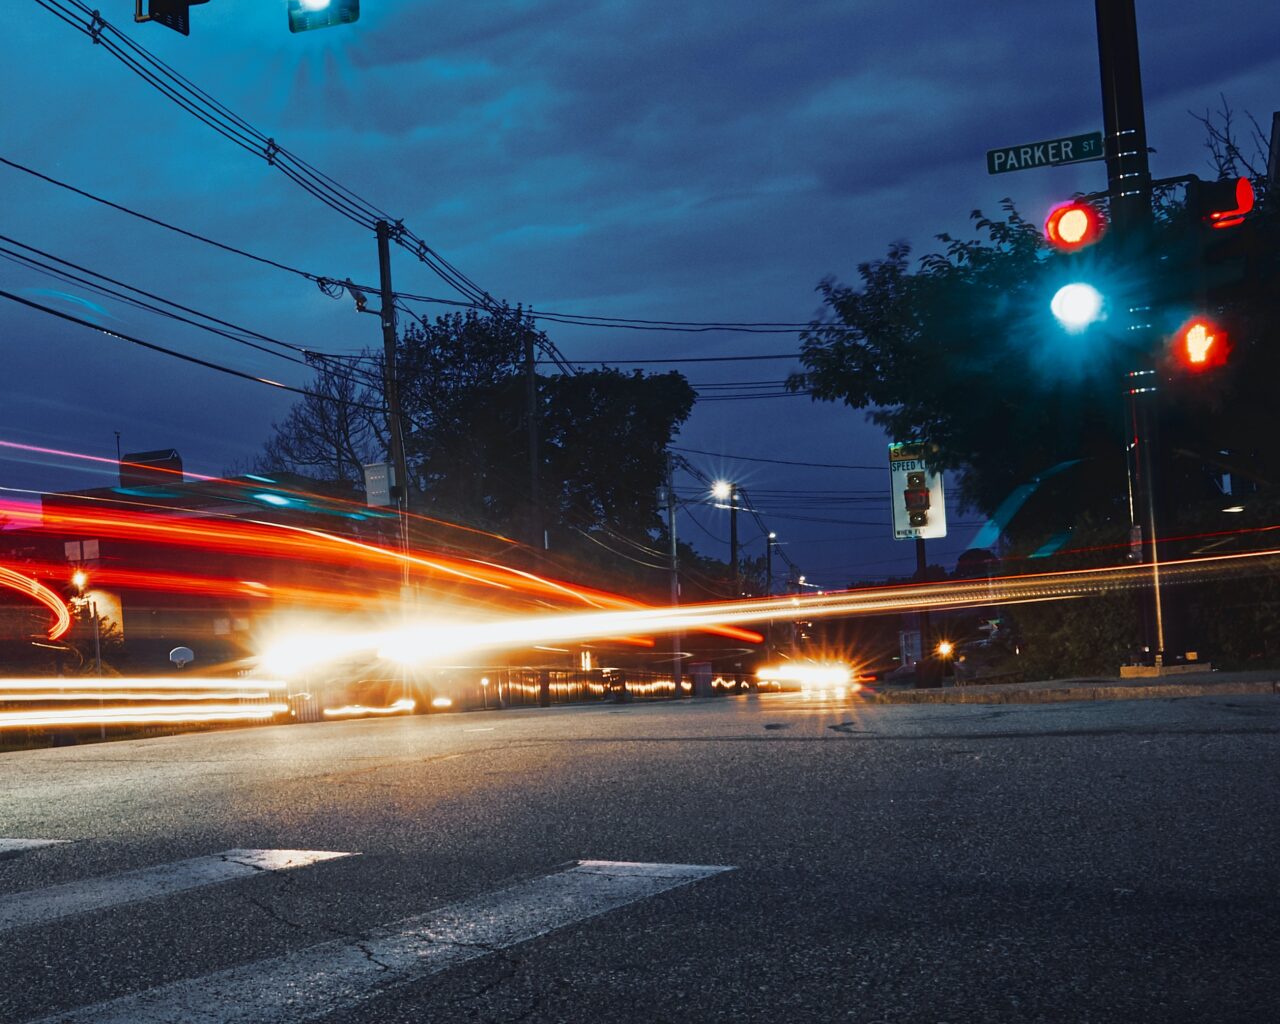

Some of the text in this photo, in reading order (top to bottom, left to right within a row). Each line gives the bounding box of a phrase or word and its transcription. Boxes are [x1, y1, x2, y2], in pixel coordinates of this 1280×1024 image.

[994, 140, 1095, 171] PARKER ST
[892, 461, 916, 472] SPEED
